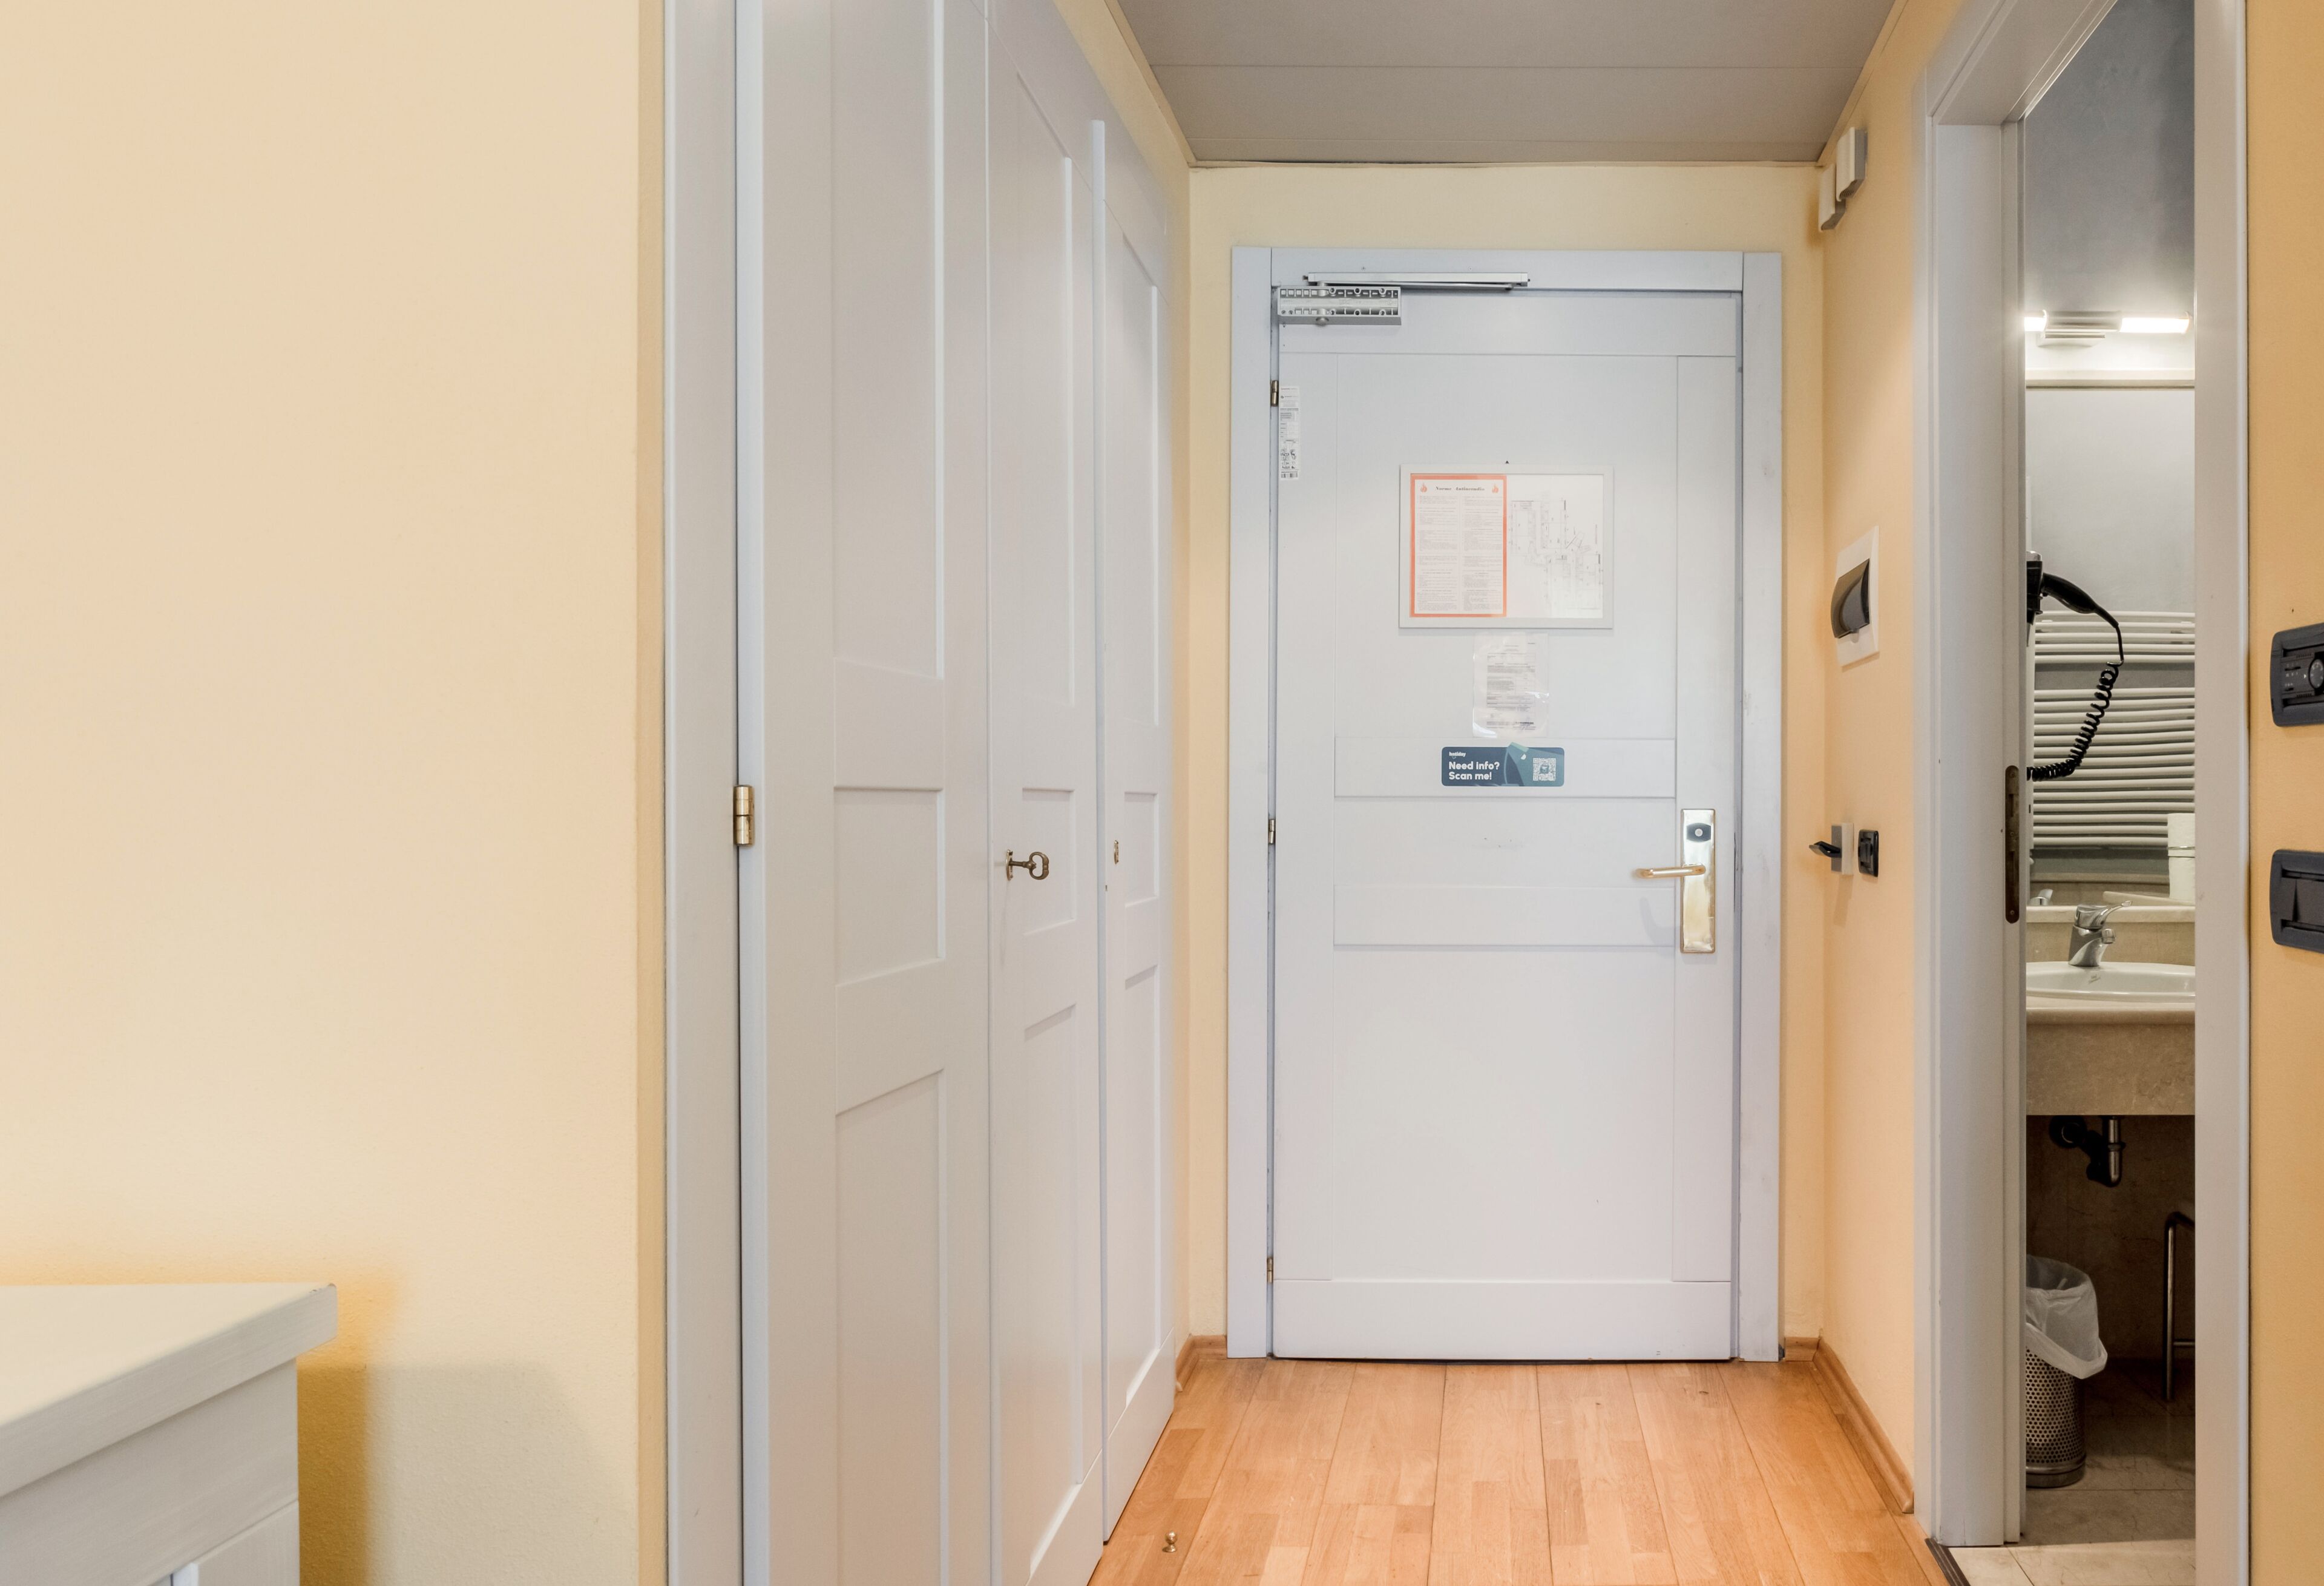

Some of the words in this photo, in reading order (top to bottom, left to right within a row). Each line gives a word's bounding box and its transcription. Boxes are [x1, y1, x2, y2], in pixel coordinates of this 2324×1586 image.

[1449, 761, 1474, 770] Need
[1476, 761, 1500, 770] info?
[1449, 771, 1472, 780] Scan
